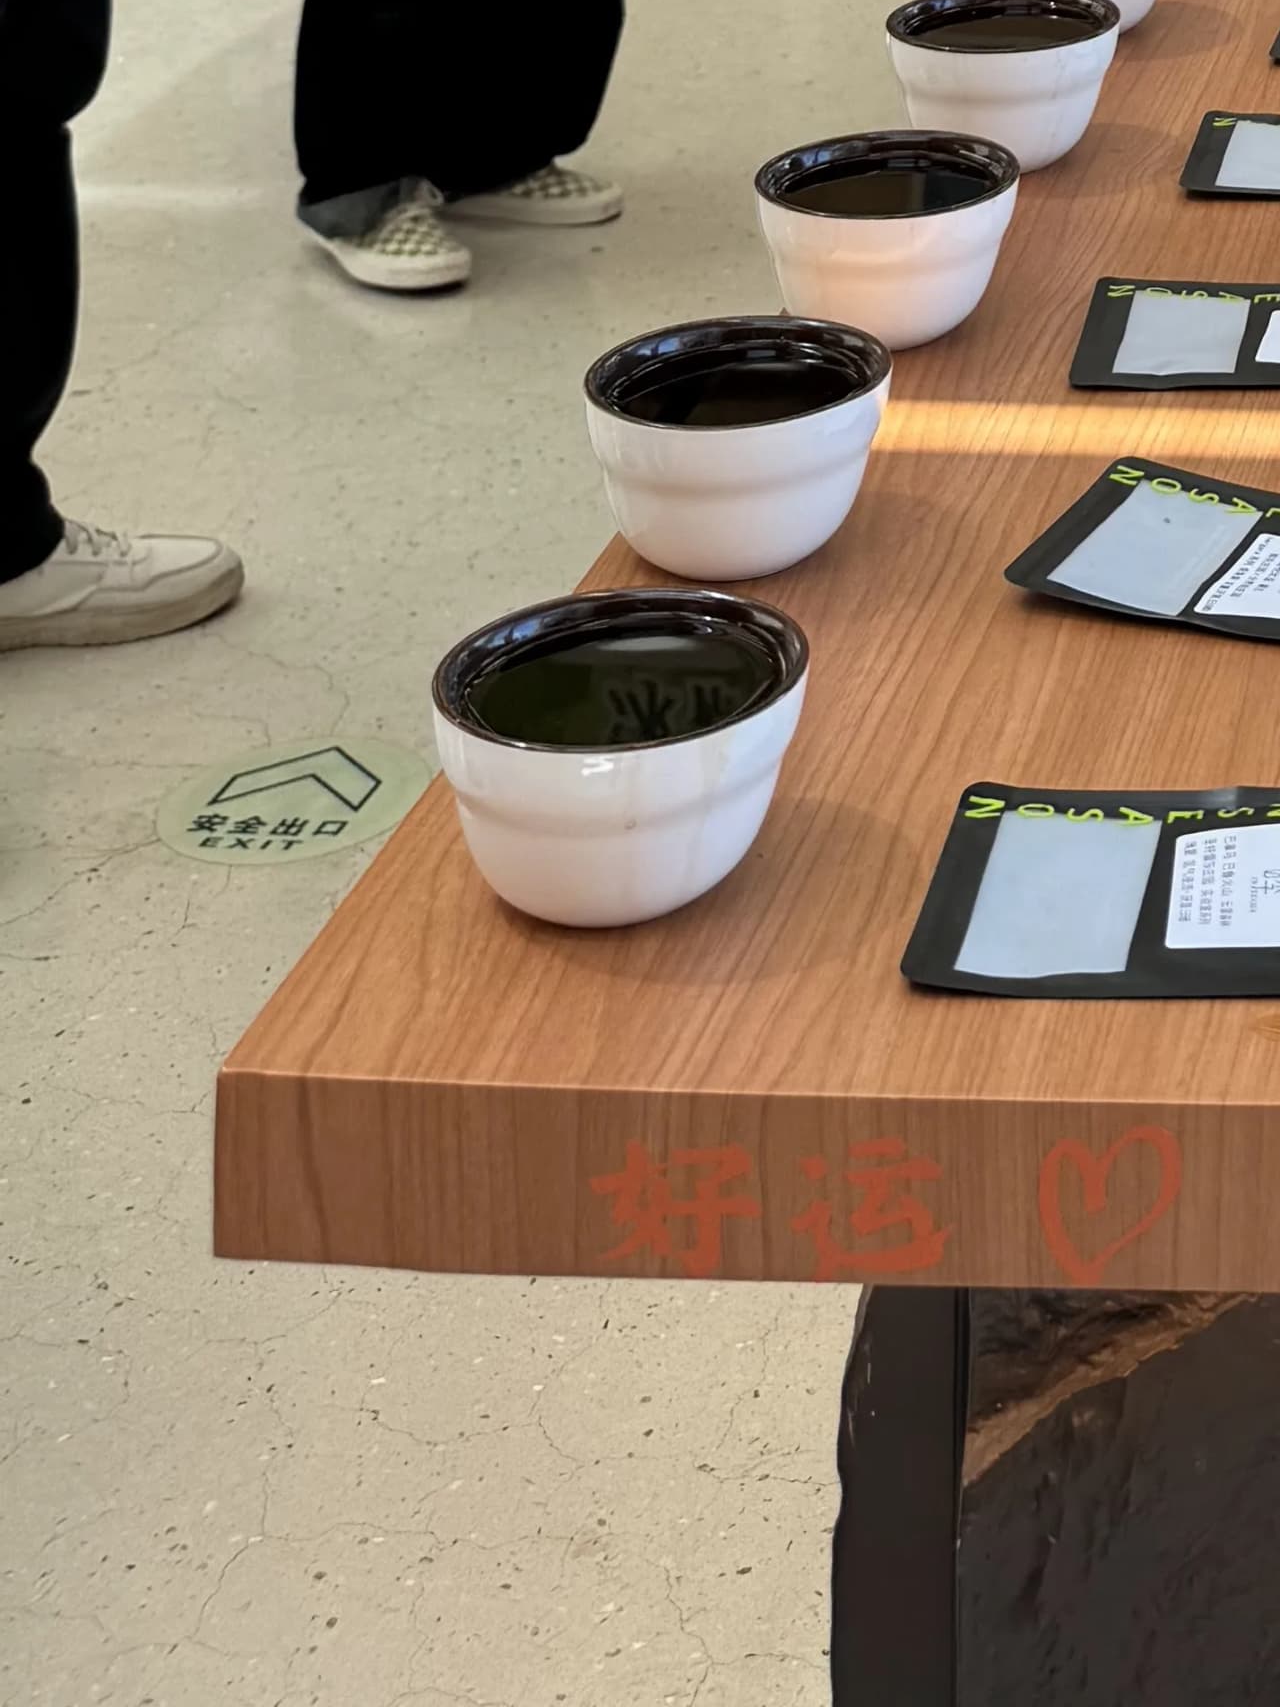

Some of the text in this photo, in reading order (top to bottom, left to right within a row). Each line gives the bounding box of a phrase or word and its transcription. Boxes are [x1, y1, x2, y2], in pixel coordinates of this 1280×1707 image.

[187, 813, 349, 837] 安全出口
[198, 837, 304, 851] EXIT
[589, 1138, 952, 1282] 好运
